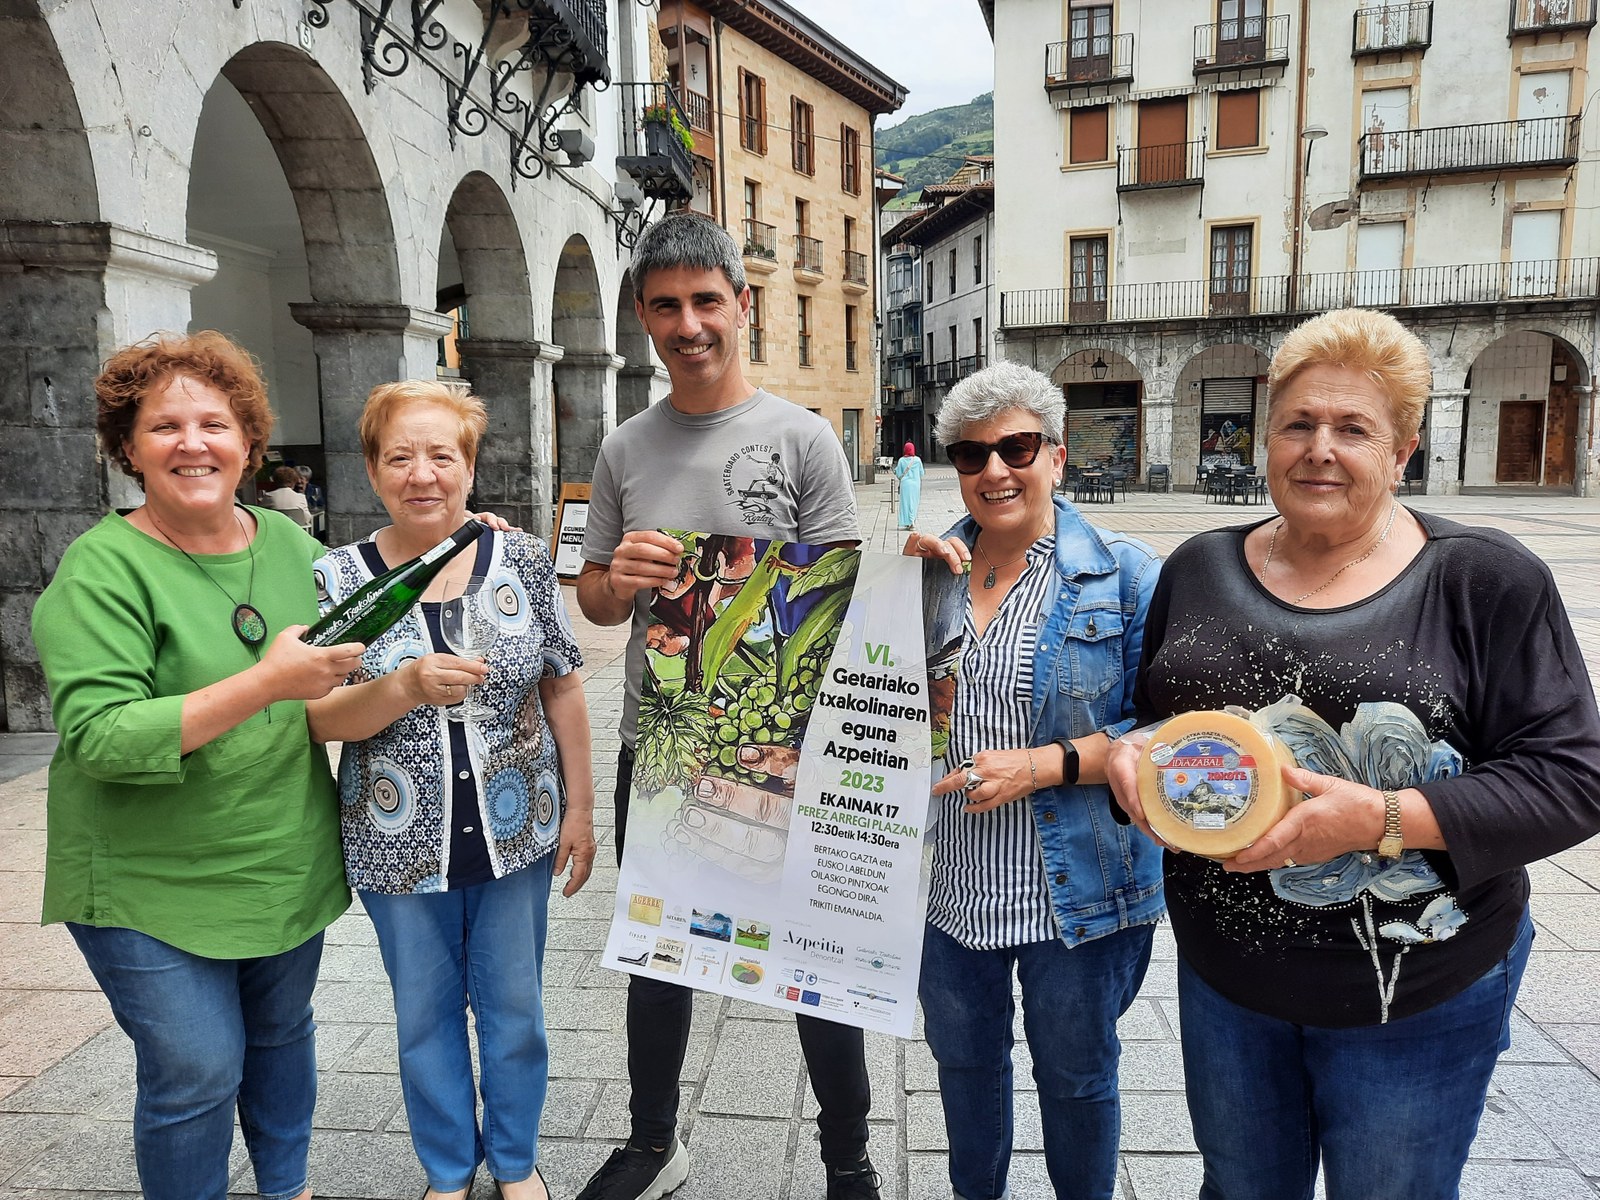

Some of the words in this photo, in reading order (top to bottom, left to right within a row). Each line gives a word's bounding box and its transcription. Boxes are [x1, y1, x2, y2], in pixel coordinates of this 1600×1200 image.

[303, 27, 310, 45] 5
[723, 452, 741, 497] SKATEBOARD
[741, 444, 773, 455] CONTEST
[342, 587, 385, 620] Txakolina
[865, 641, 895, 668] VI.
[832, 667, 920, 696] Getariako
[819, 691, 928, 723] txakolinaren
[841, 721, 898, 743] eguna
[823, 740, 909, 771] Azpeitian
[839, 769, 885, 793] 2023
[819, 791, 884, 816] EKAINAK
[885, 804, 900, 819] 17
[797, 804, 829, 820] PEREZ
[829, 811, 870, 829] ARREGI
[872, 819, 919, 839] PLAZAN
[811, 821, 856, 841] 12:30etik
[856, 830, 900, 850] 14:30era
[813, 844, 849, 859] BERTAKO
[849, 852, 878, 866] GAZTA
[879, 859, 893, 868] eta
[810, 869, 847, 885] OILASKO
[847, 877, 889, 894] PINTXOAK
[817, 858, 844, 871] EUSKO
[845, 863, 886, 880] LABELDUN
[817, 884, 857, 900] EGONGO
[857, 893, 879, 905] DIRA.
[809, 898, 833, 911] TRIKITI
[833, 904, 885, 922] EMANALDIA.
[656, 941, 684, 954] GAÑETA
[783, 930, 844, 955] Azpeitia
